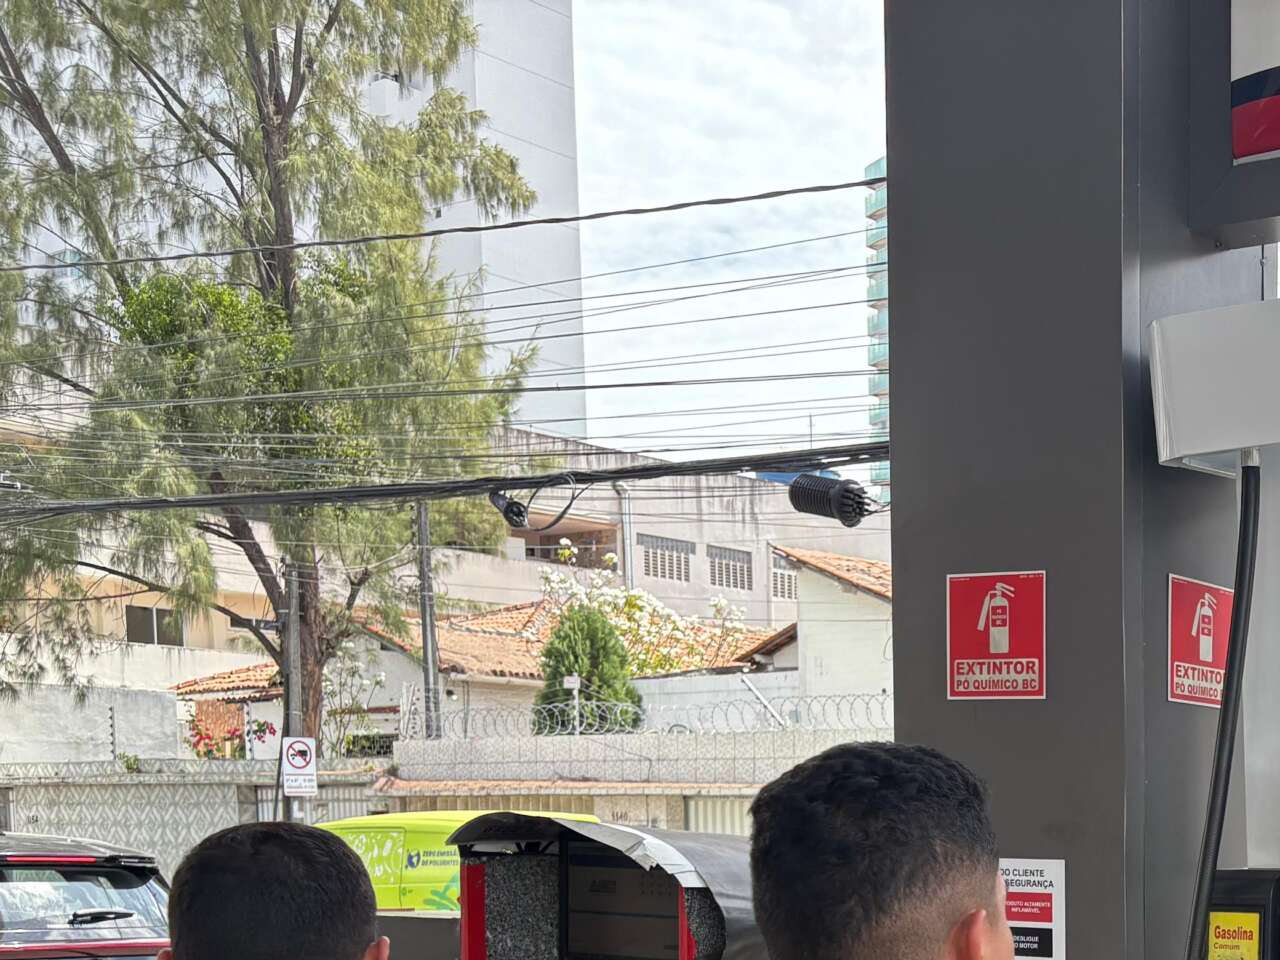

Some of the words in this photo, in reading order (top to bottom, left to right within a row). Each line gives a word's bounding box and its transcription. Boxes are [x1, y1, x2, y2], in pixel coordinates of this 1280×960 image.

[956, 661, 1036, 675] EXTINTOR
[1175, 664, 1225, 685] EXTINTO
[957, 677, 969, 689] PÓ
[973, 677, 1018, 689] QUÍMICO
[1022, 679, 1037, 689] BC
[1175, 681, 1185, 693] PÓ
[1187, 682, 1218, 698] QUÍMICO
[1012, 869, 1045, 877] CLIENTE
[1005, 879, 1055, 890] SEGURANÇA
[1214, 925, 1254, 941] Gasolina
